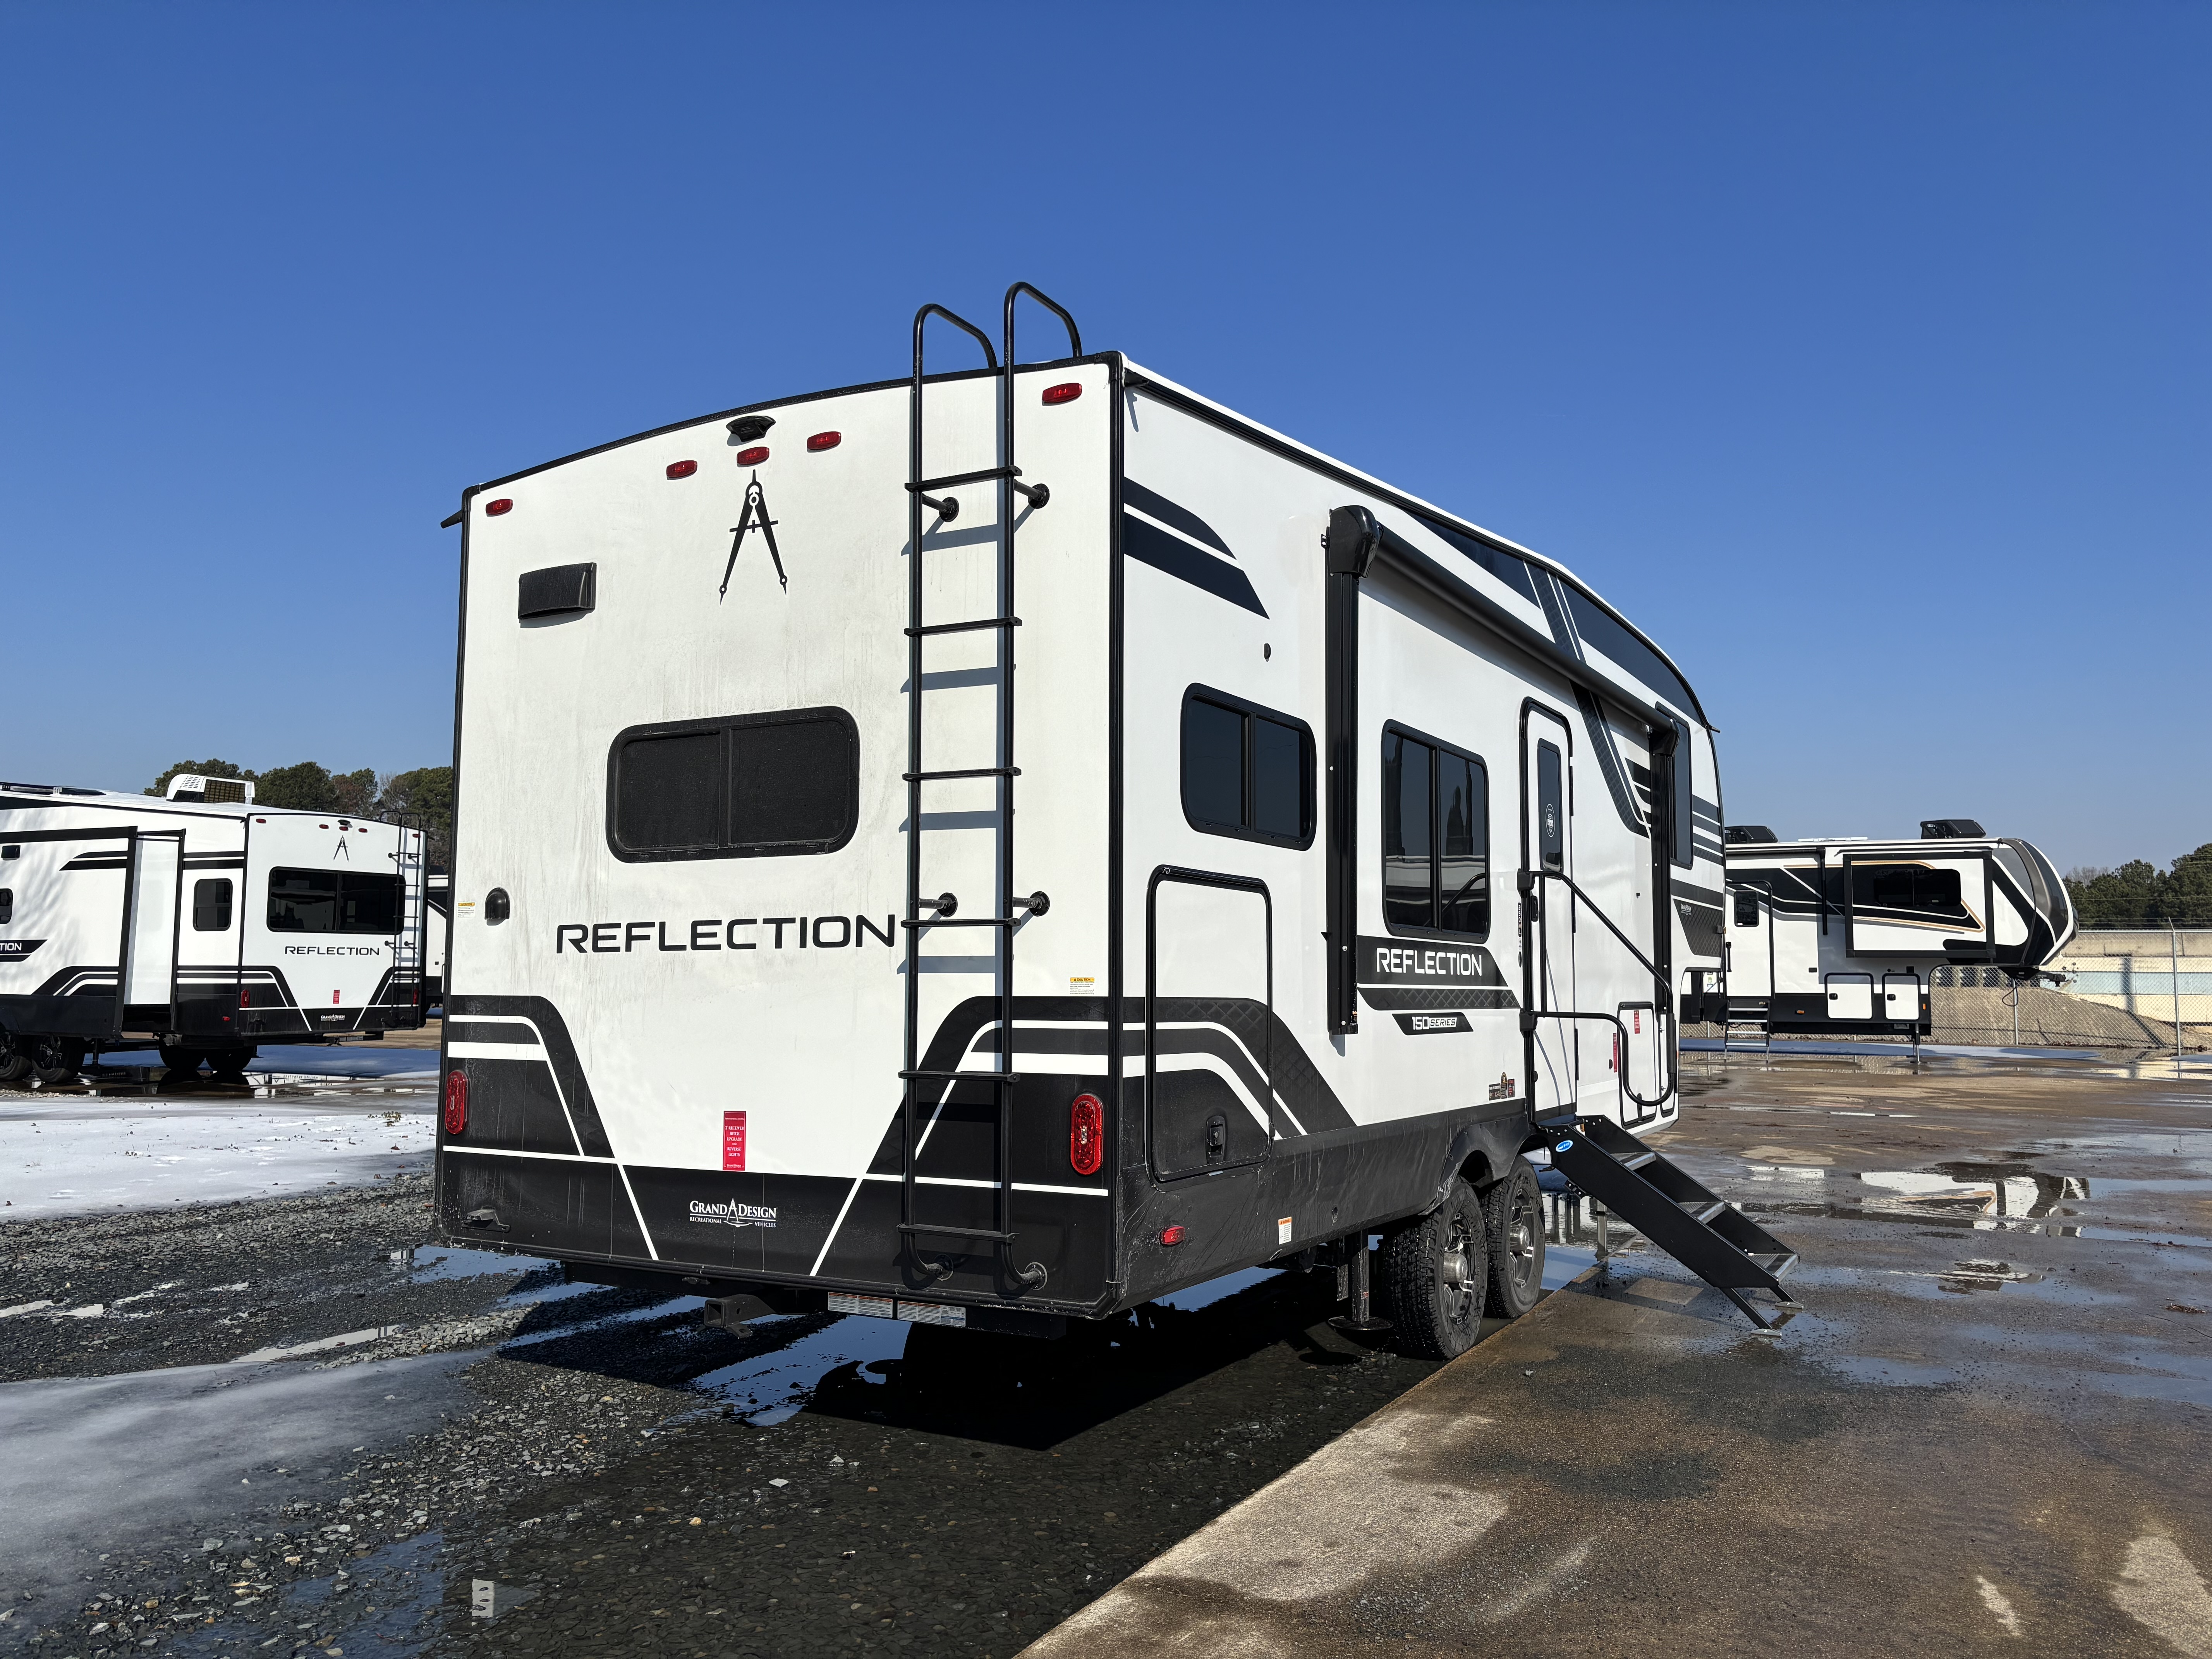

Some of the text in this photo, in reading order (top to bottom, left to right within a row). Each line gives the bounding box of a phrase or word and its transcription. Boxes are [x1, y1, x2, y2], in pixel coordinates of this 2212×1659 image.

[556, 914, 896, 954] REFLECTION
[285, 946, 380, 956] REFLECTION
[1376, 947, 1482, 977] REFLECTION
[1412, 1016, 1429, 1030] 150
[689, 1200, 776, 1218] GRAND DESIGN
